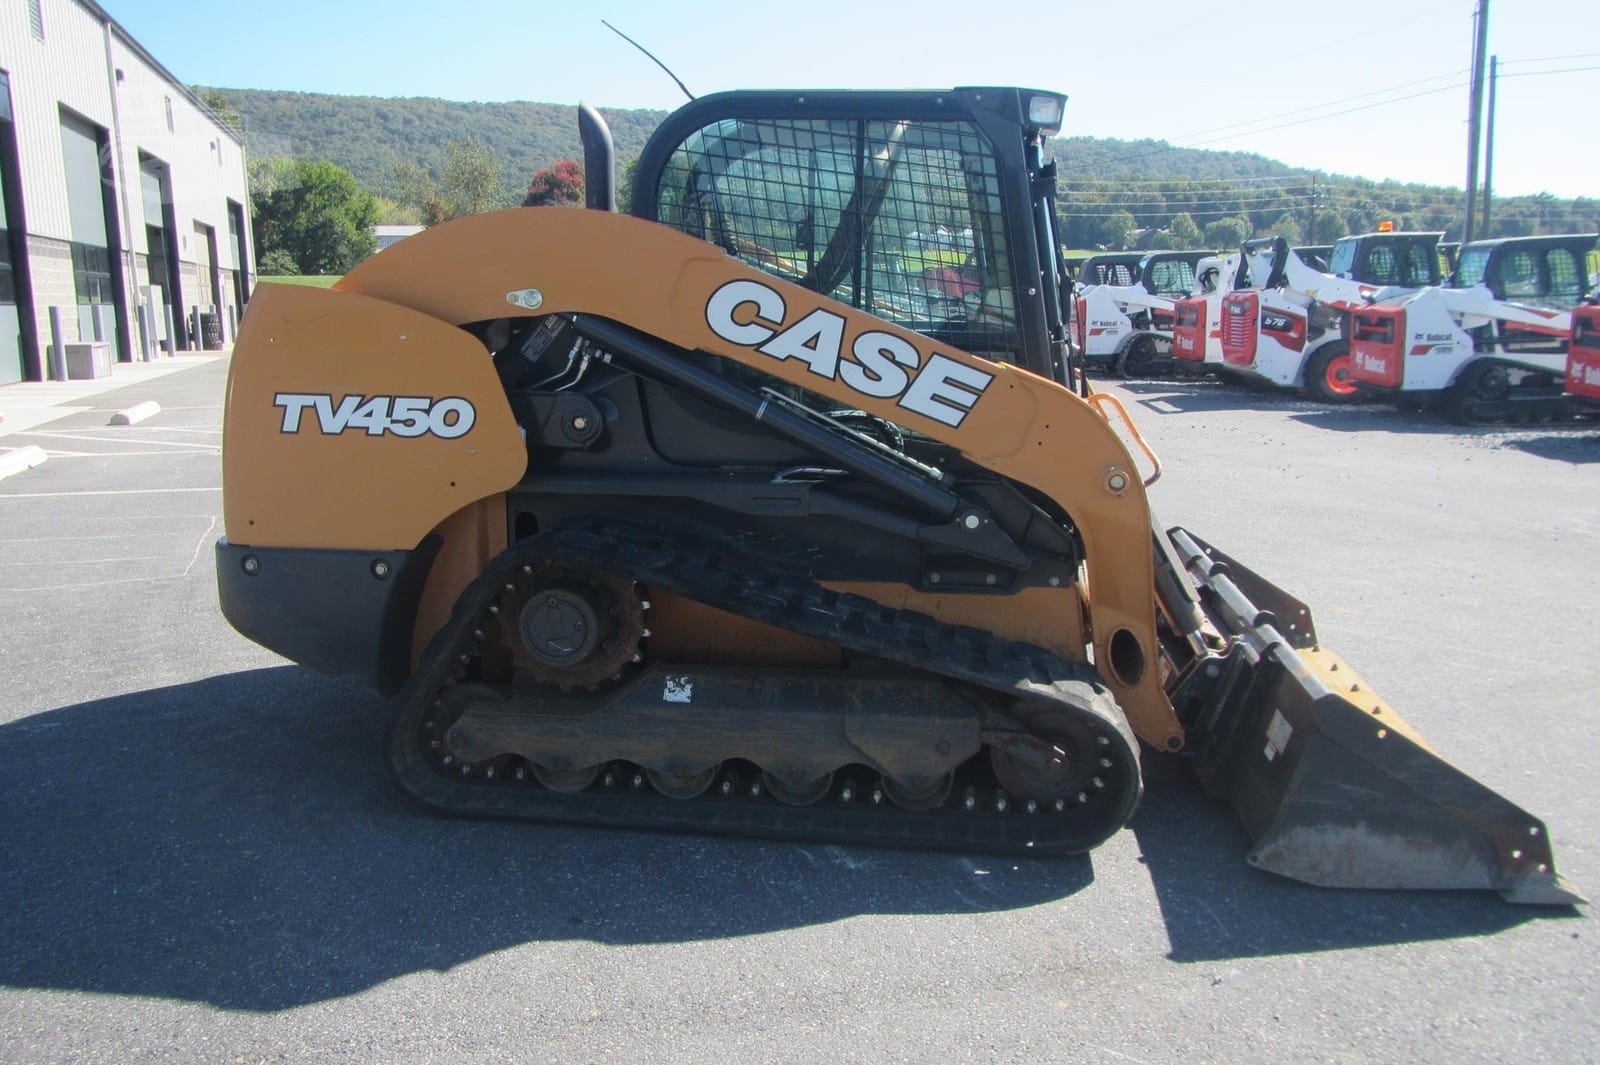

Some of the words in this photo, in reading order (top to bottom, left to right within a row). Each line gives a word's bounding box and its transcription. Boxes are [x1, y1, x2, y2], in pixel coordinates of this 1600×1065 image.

[705, 279, 996, 429] CASE
[1426, 333, 1452, 342] Bobcat
[273, 392, 476, 439] TV450
